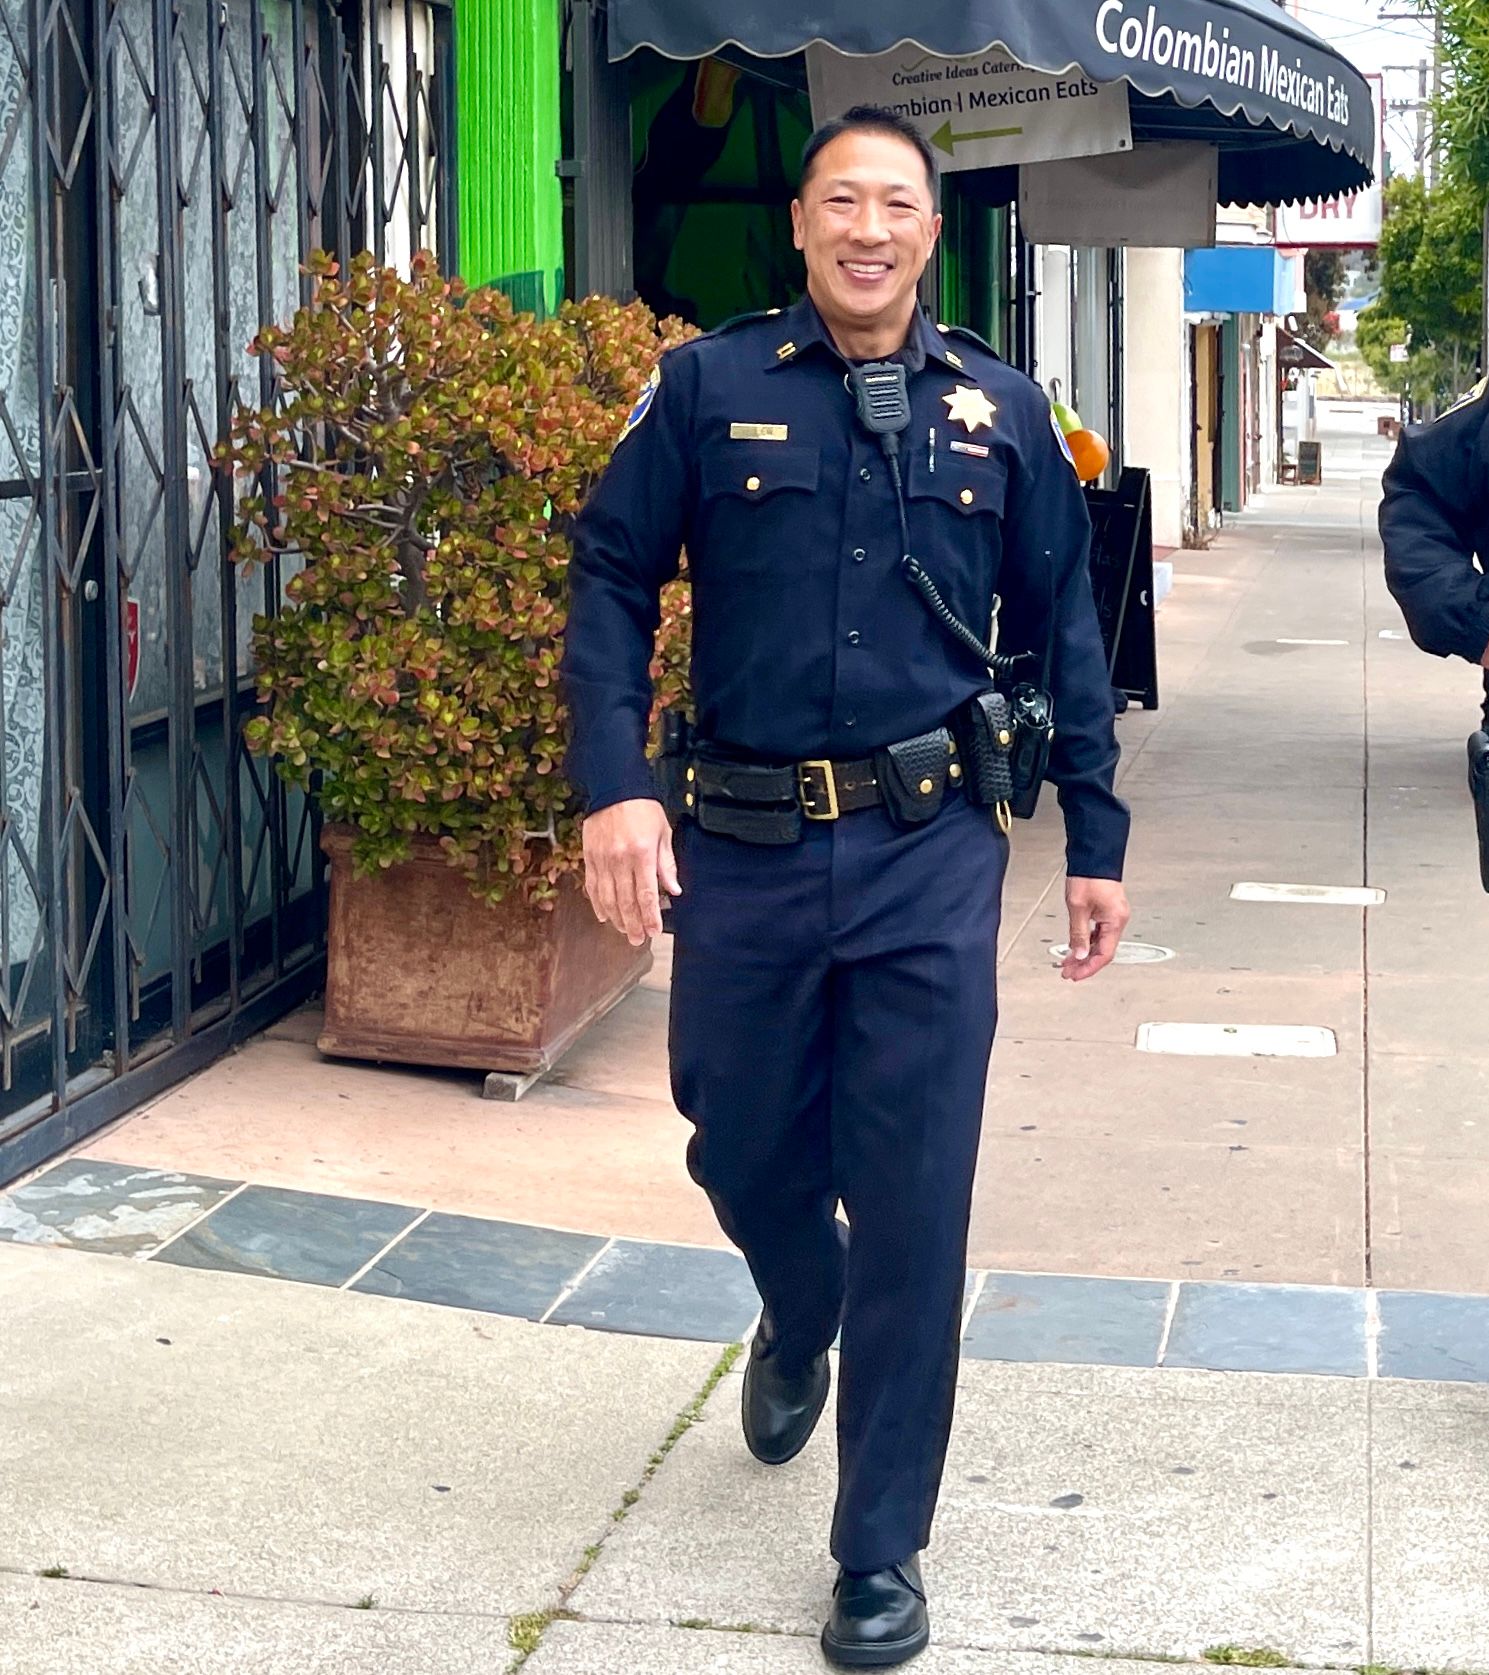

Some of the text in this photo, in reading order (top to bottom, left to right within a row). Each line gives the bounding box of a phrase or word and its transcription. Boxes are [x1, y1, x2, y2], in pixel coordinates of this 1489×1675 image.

[892, 61, 1036, 86] Creative Ideas Cateri
[1095, 0, 1349, 126] Colombian Mexican Eats
[969, 84, 1050, 110] Mexican
[1056, 78, 1098, 99] Eats
